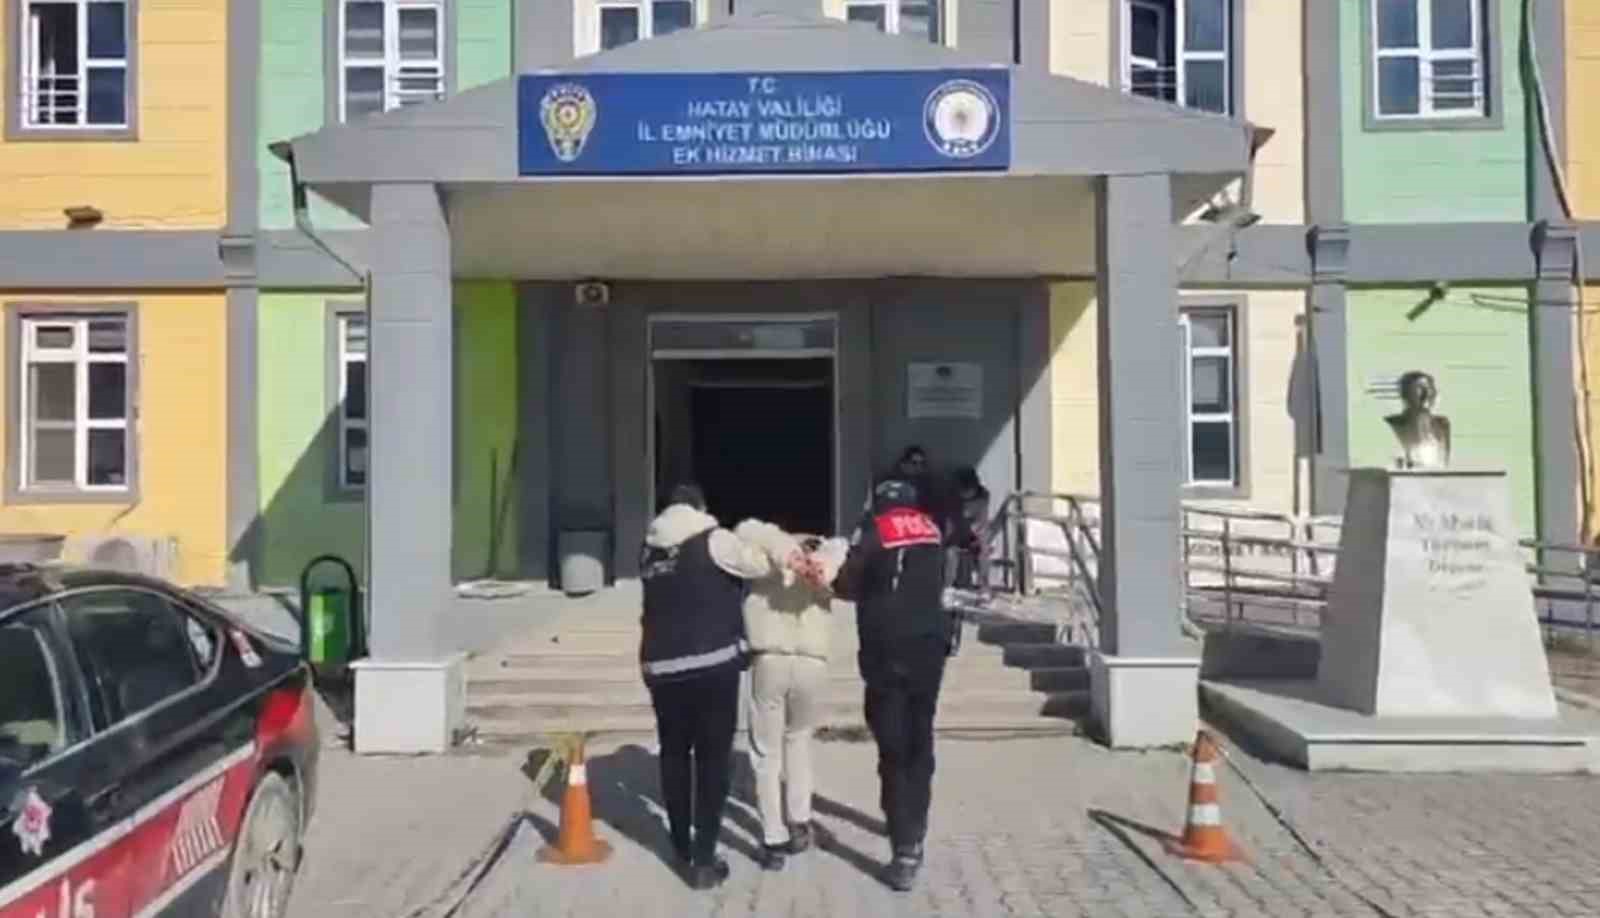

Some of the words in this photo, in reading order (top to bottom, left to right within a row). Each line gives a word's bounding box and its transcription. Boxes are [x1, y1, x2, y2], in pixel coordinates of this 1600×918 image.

[687, 100, 750, 118] HATAY
[661, 120, 752, 142] EMNİYET
[673, 147, 700, 165] EK
